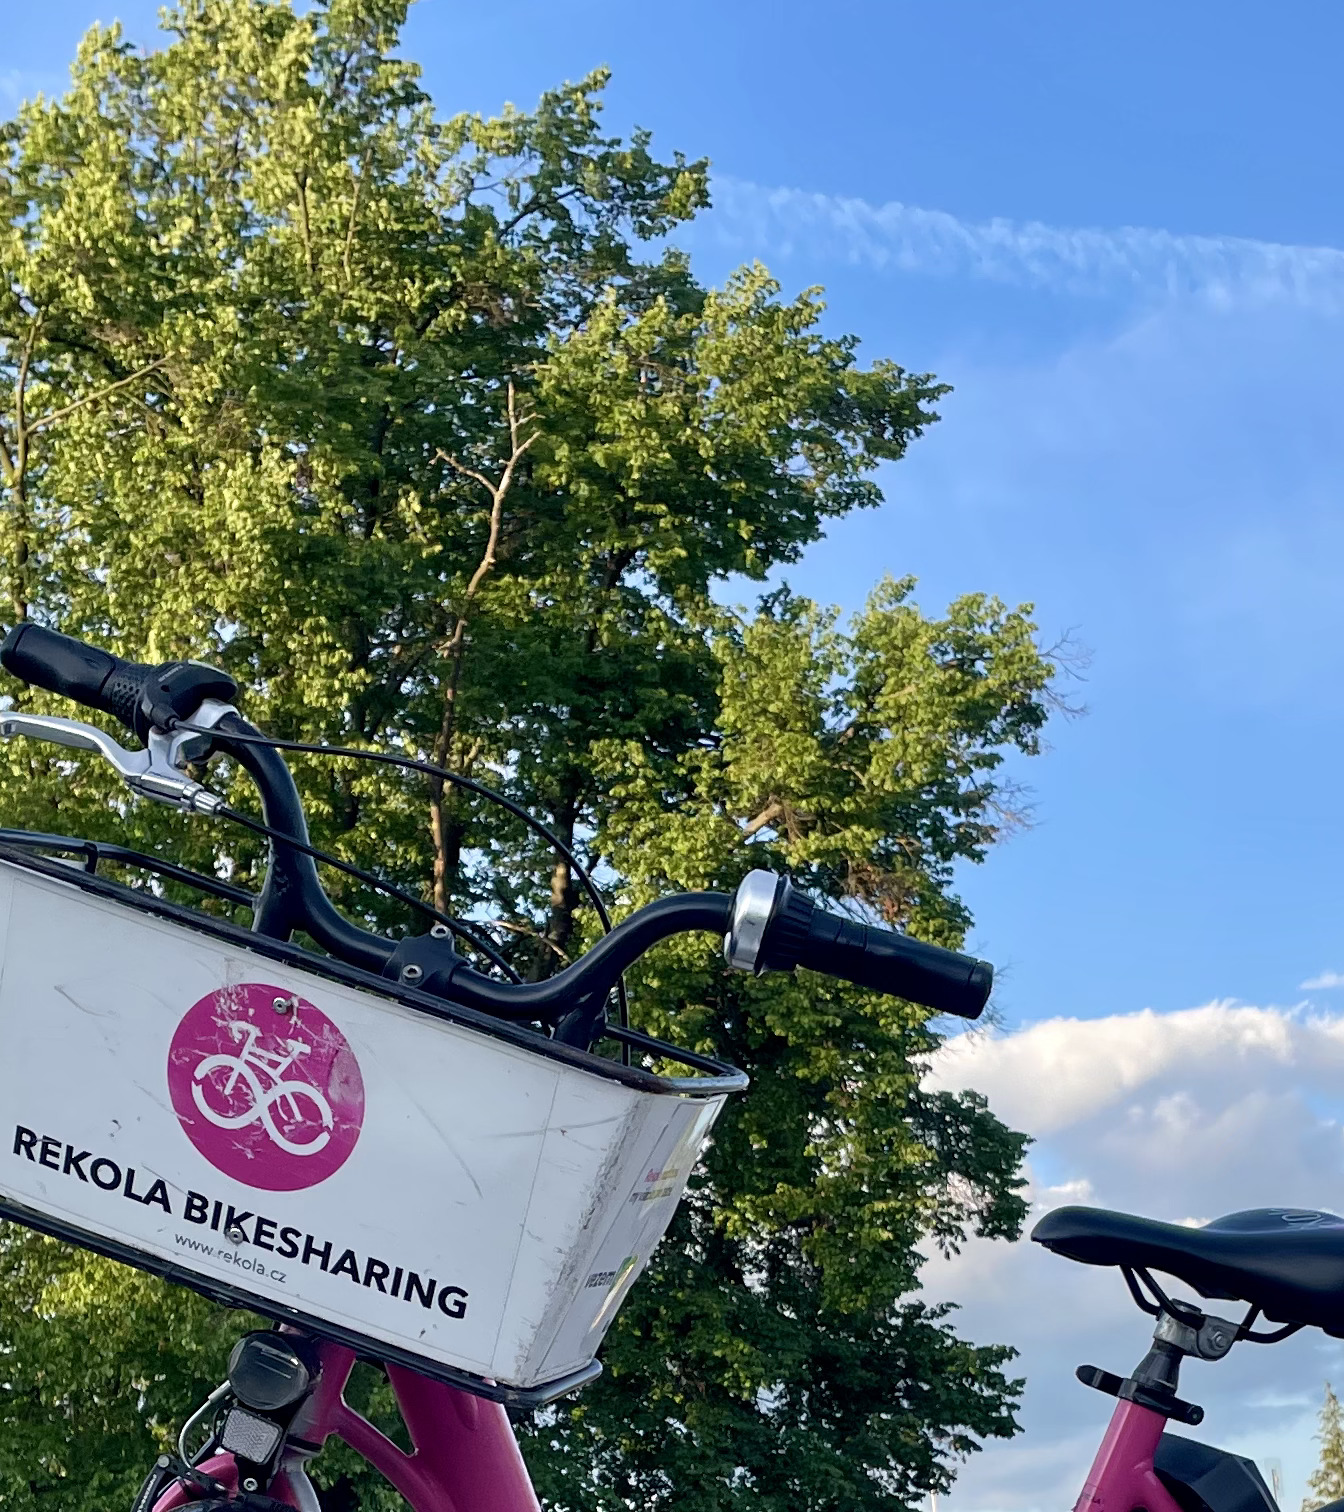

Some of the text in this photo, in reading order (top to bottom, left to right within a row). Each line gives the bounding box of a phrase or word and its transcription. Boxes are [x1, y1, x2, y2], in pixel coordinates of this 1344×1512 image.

[13, 1125, 470, 1320] REKOLA BIKESHARING
[174, 1231, 288, 1284] www.rekola.cz
